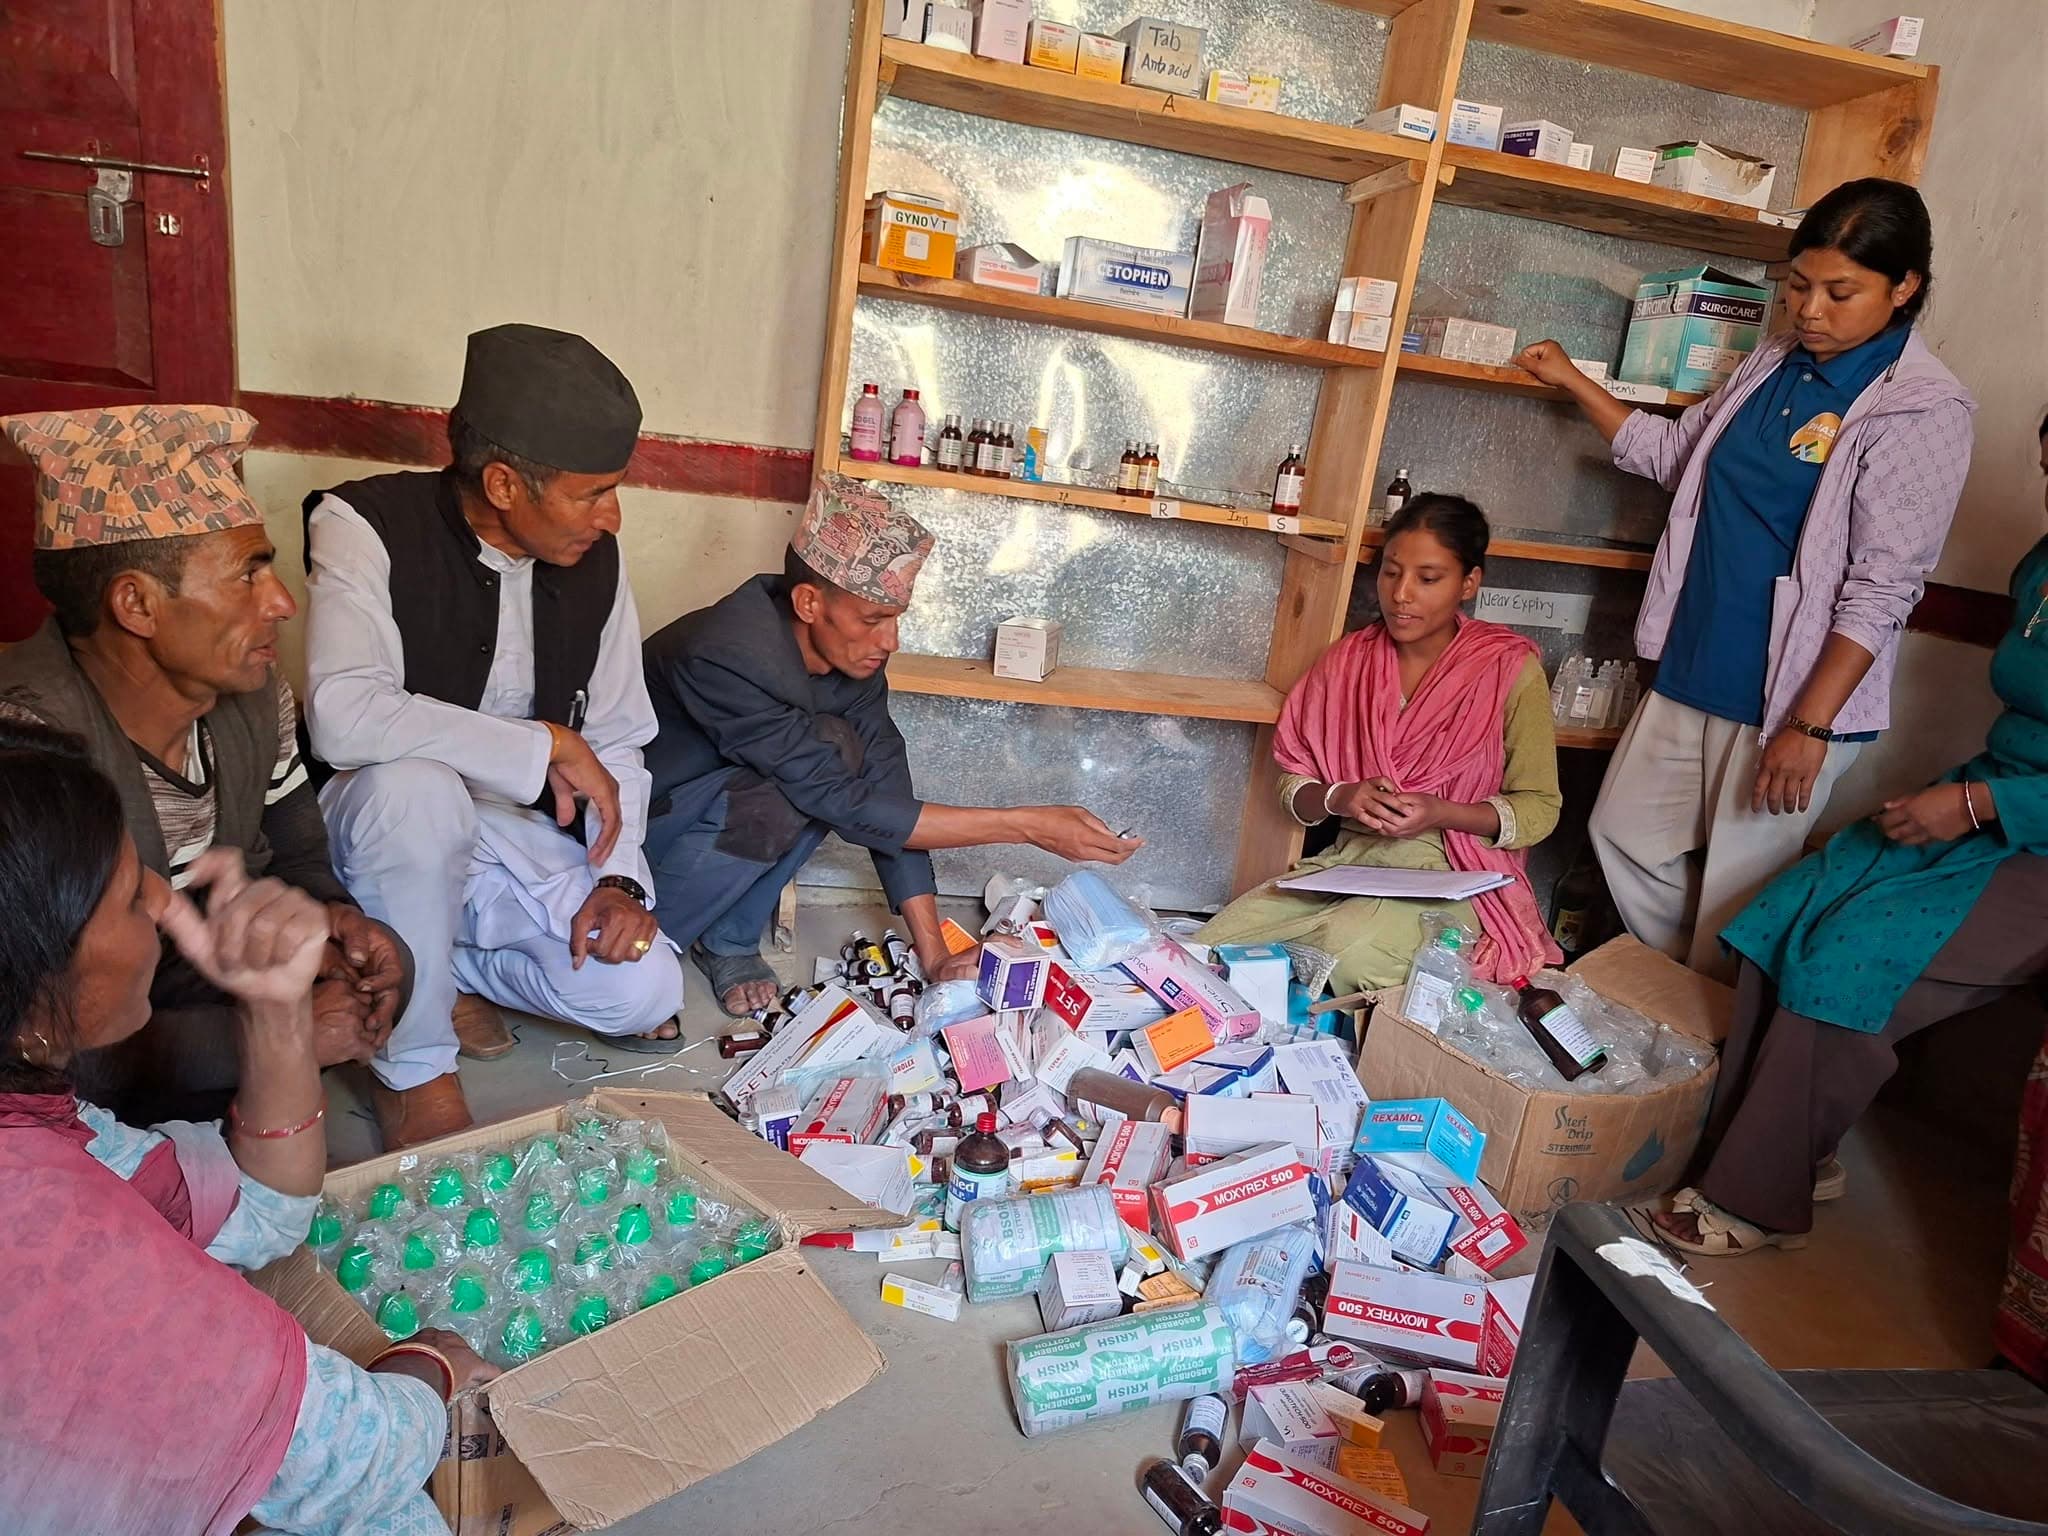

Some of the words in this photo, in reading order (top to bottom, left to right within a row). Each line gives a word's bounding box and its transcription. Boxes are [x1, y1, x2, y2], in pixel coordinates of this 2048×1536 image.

[1149, 26, 1181, 51] Tab
[1162, 95, 1175, 112] A
[895, 211, 928, 227] GYNO
[1097, 263, 1169, 287] CETOPHEN
[1700, 301, 1758, 318] SURGICARE
[1159, 502, 1168, 517] R
[1276, 517, 1286, 530] S
[1480, 591, 1510, 609] Near
[1512, 594, 1555, 618] Expiry
[1056, 991, 1081, 1016] SET
[737, 1066, 768, 1097] SET
[1372, 1113, 1424, 1123] REXAMOL
[1446, 1113, 1473, 1140] REXAMOL
[1567, 1128, 1594, 1142] Drip
[1109, 1138, 1127, 1165] MOXYREX
[1121, 1125, 1133, 1137] 500
[1214, 1178, 1270, 1206] MOXYREX
[1271, 1169, 1293, 1184] 500
[1467, 1206, 1482, 1221] 500
[1458, 1224, 1491, 1250] MOXYREX
[1491, 1215, 1505, 1229] 500
[1338, 1300, 1363, 1314] 500
[1151, 1315, 1202, 1331] ABSORBENT
[1154, 1310, 1190, 1323] COTTON
[1366, 1307, 1429, 1329] MOXYREX
[1035, 1336, 1071, 1350] COTTON
[1097, 1331, 1139, 1348] KRISH
[1162, 1336, 1203, 1354] KRISH
[1029, 1341, 1081, 1358] ABSORBENT
[1037, 1360, 1079, 1378] KRISH
[1162, 1367, 1213, 1385] ABSORBENT
[1168, 1360, 1204, 1375] COTTON
[1046, 1386, 1082, 1401] COTTON
[1108, 1382, 1149, 1400] KRISH
[1039, 1393, 1092, 1411] ABSORBENT
[1301, 1477, 1373, 1519] MOXYREX
[1376, 1515, 1407, 1535] 500
